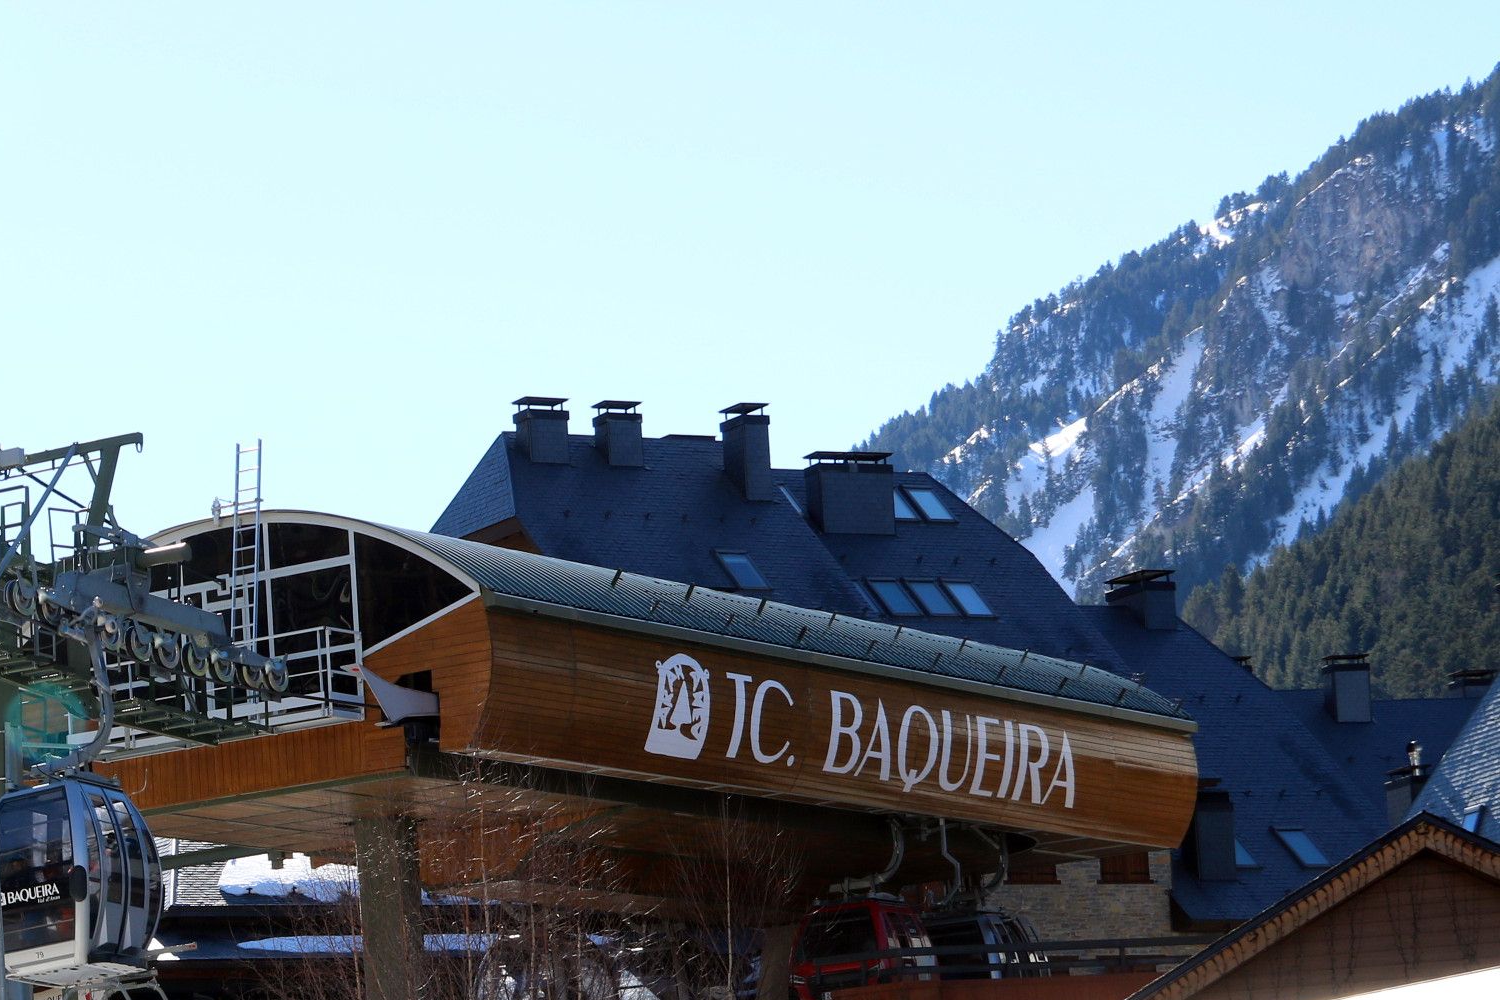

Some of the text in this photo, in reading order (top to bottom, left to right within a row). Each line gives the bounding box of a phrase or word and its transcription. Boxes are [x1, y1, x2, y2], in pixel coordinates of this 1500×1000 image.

[725, 672, 1075, 809] TC. BAQUEIRA
[7, 883, 59, 903] BAQUEIRA
